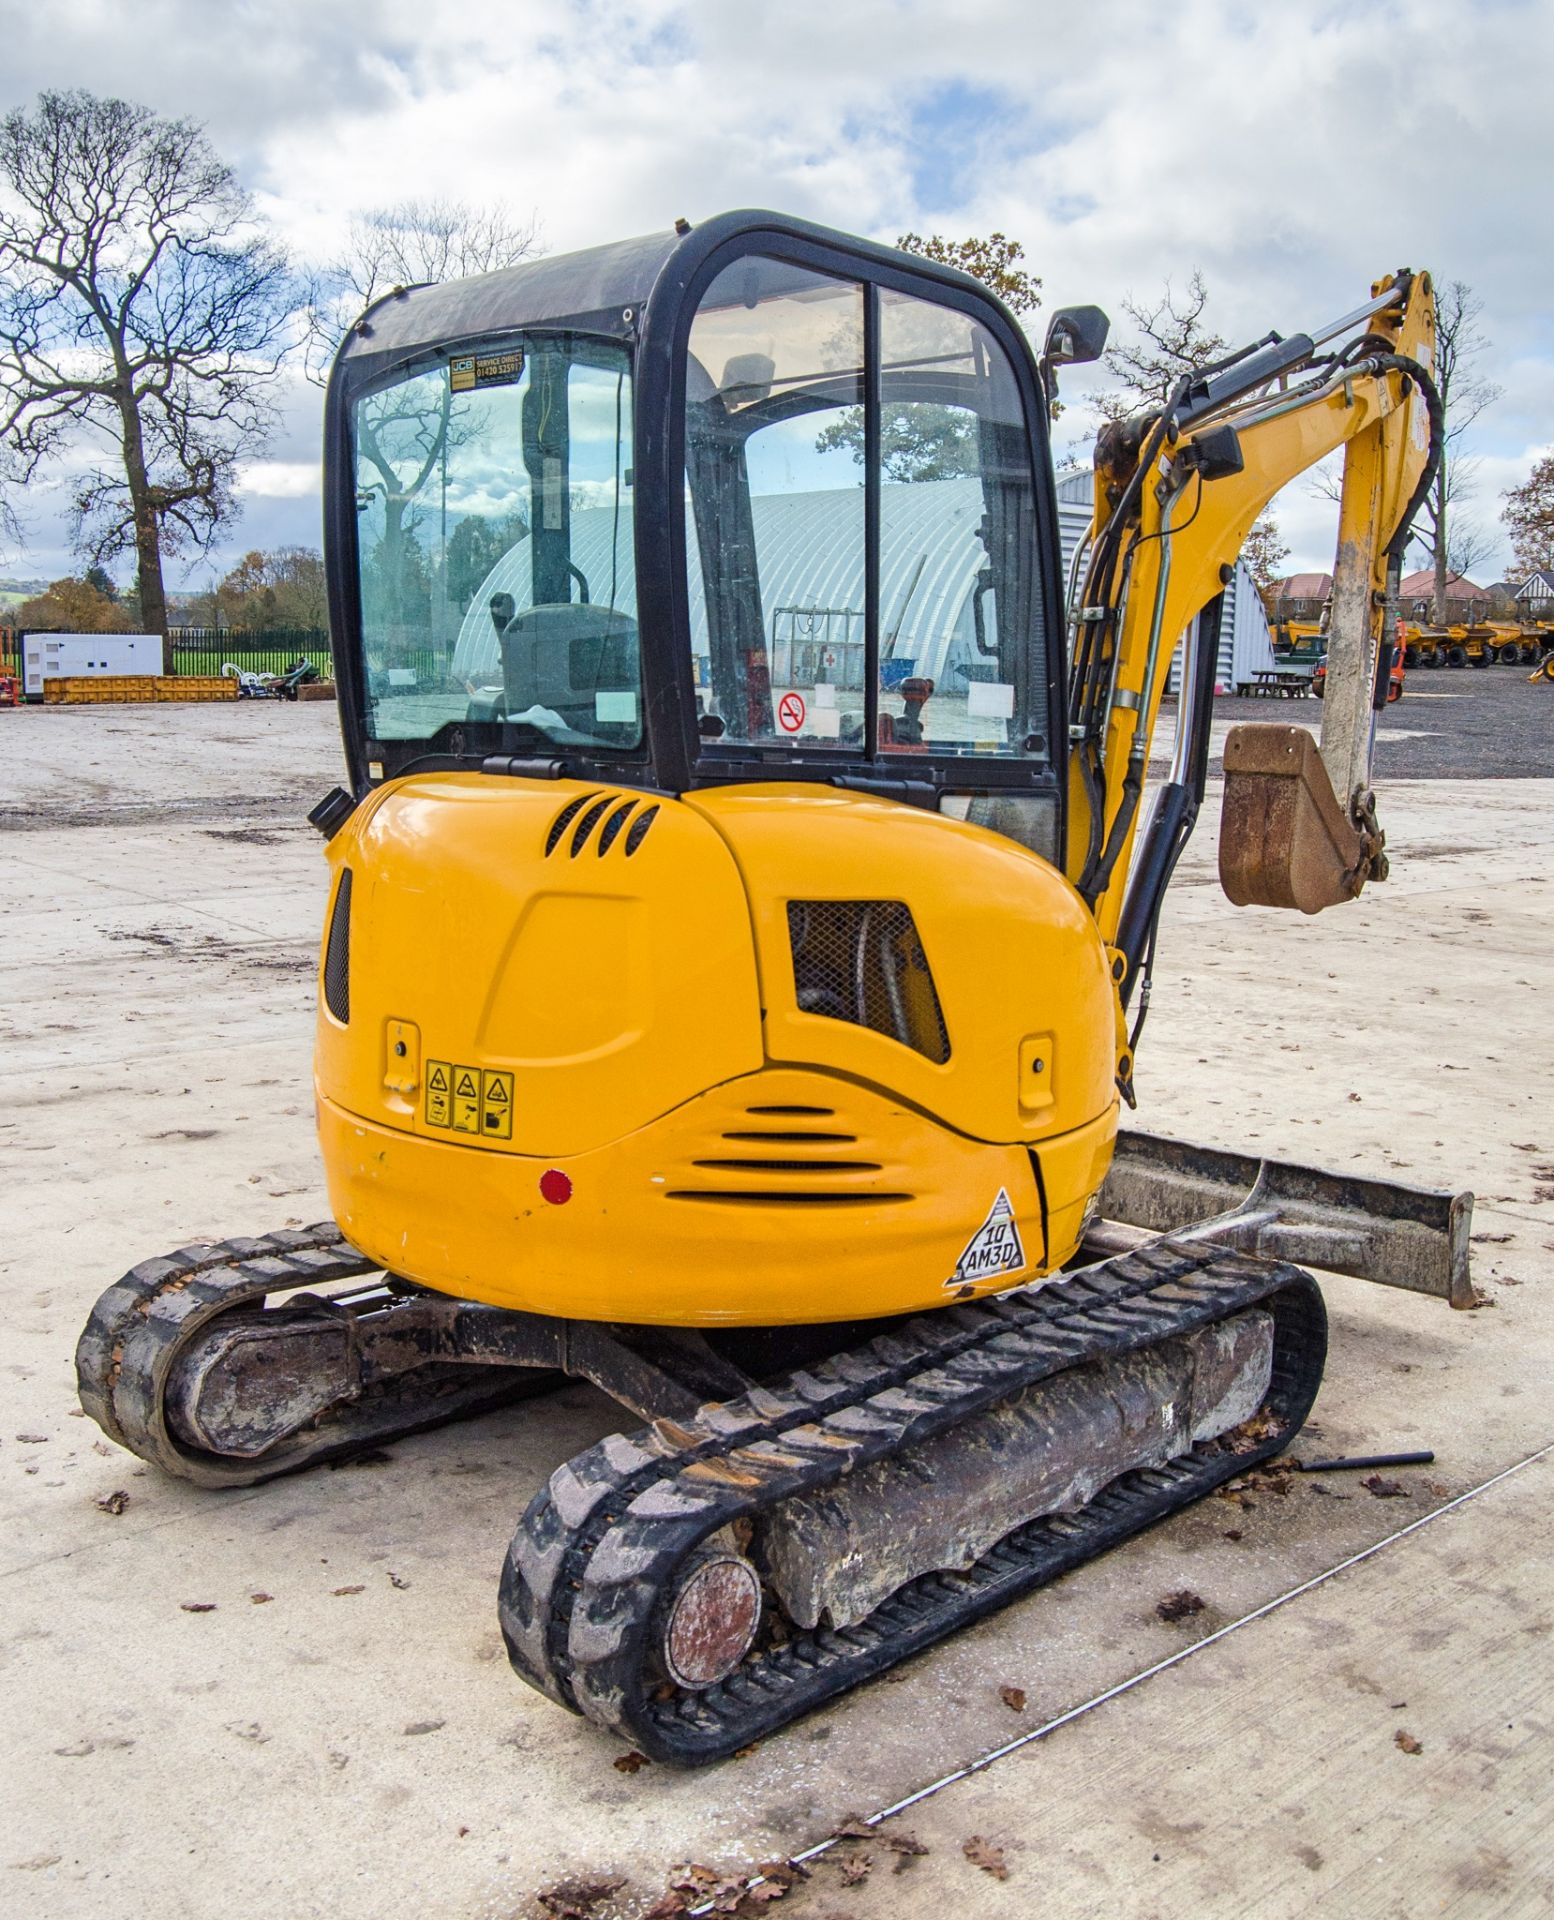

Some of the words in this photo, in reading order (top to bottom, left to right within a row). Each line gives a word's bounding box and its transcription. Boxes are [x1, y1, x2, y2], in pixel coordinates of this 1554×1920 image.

[453, 360, 473, 371] JCB
[476, 358, 500, 368] SERVICE
[501, 354, 522, 363] DIRECT
[476, 367, 497, 377] 01420
[983, 1224, 1007, 1246] 10
[966, 1243, 1014, 1272] AM3D
